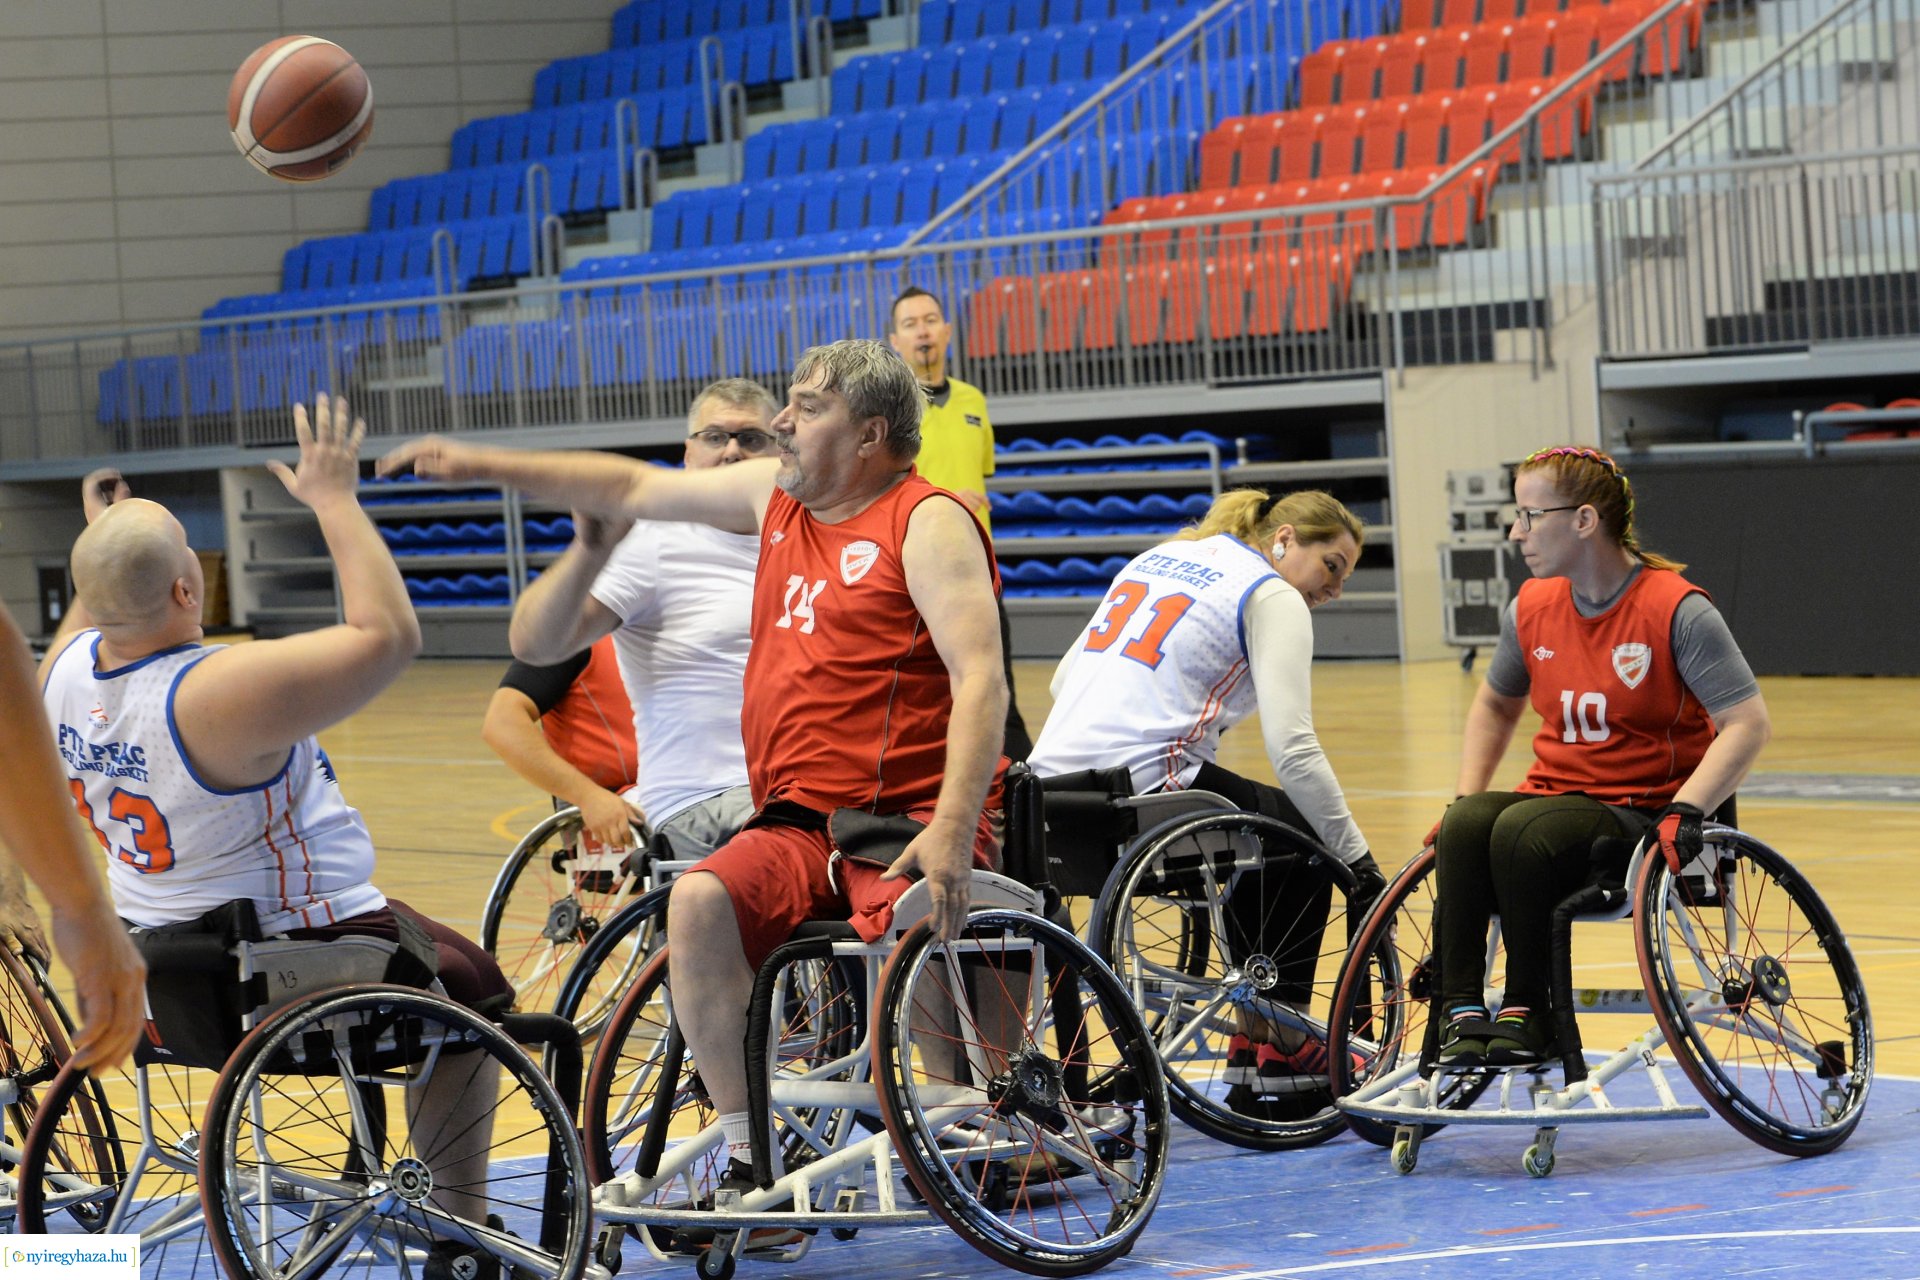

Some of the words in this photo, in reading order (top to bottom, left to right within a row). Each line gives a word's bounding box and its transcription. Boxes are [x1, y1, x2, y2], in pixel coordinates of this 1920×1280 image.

[1132, 564, 1169, 577] ROLLING
[1168, 572, 1211, 590] BASKET
[1142, 554, 1178, 569] PTE
[1173, 558, 1224, 583] PEAC
[775, 574, 828, 634] 14
[1083, 579, 1197, 672] 31
[1560, 690, 1610, 743] 10
[58, 723, 87, 760] PTE
[89, 742, 146, 766] PEAC
[105, 762, 149, 783] BASKET
[278, 970, 298, 989] 13
